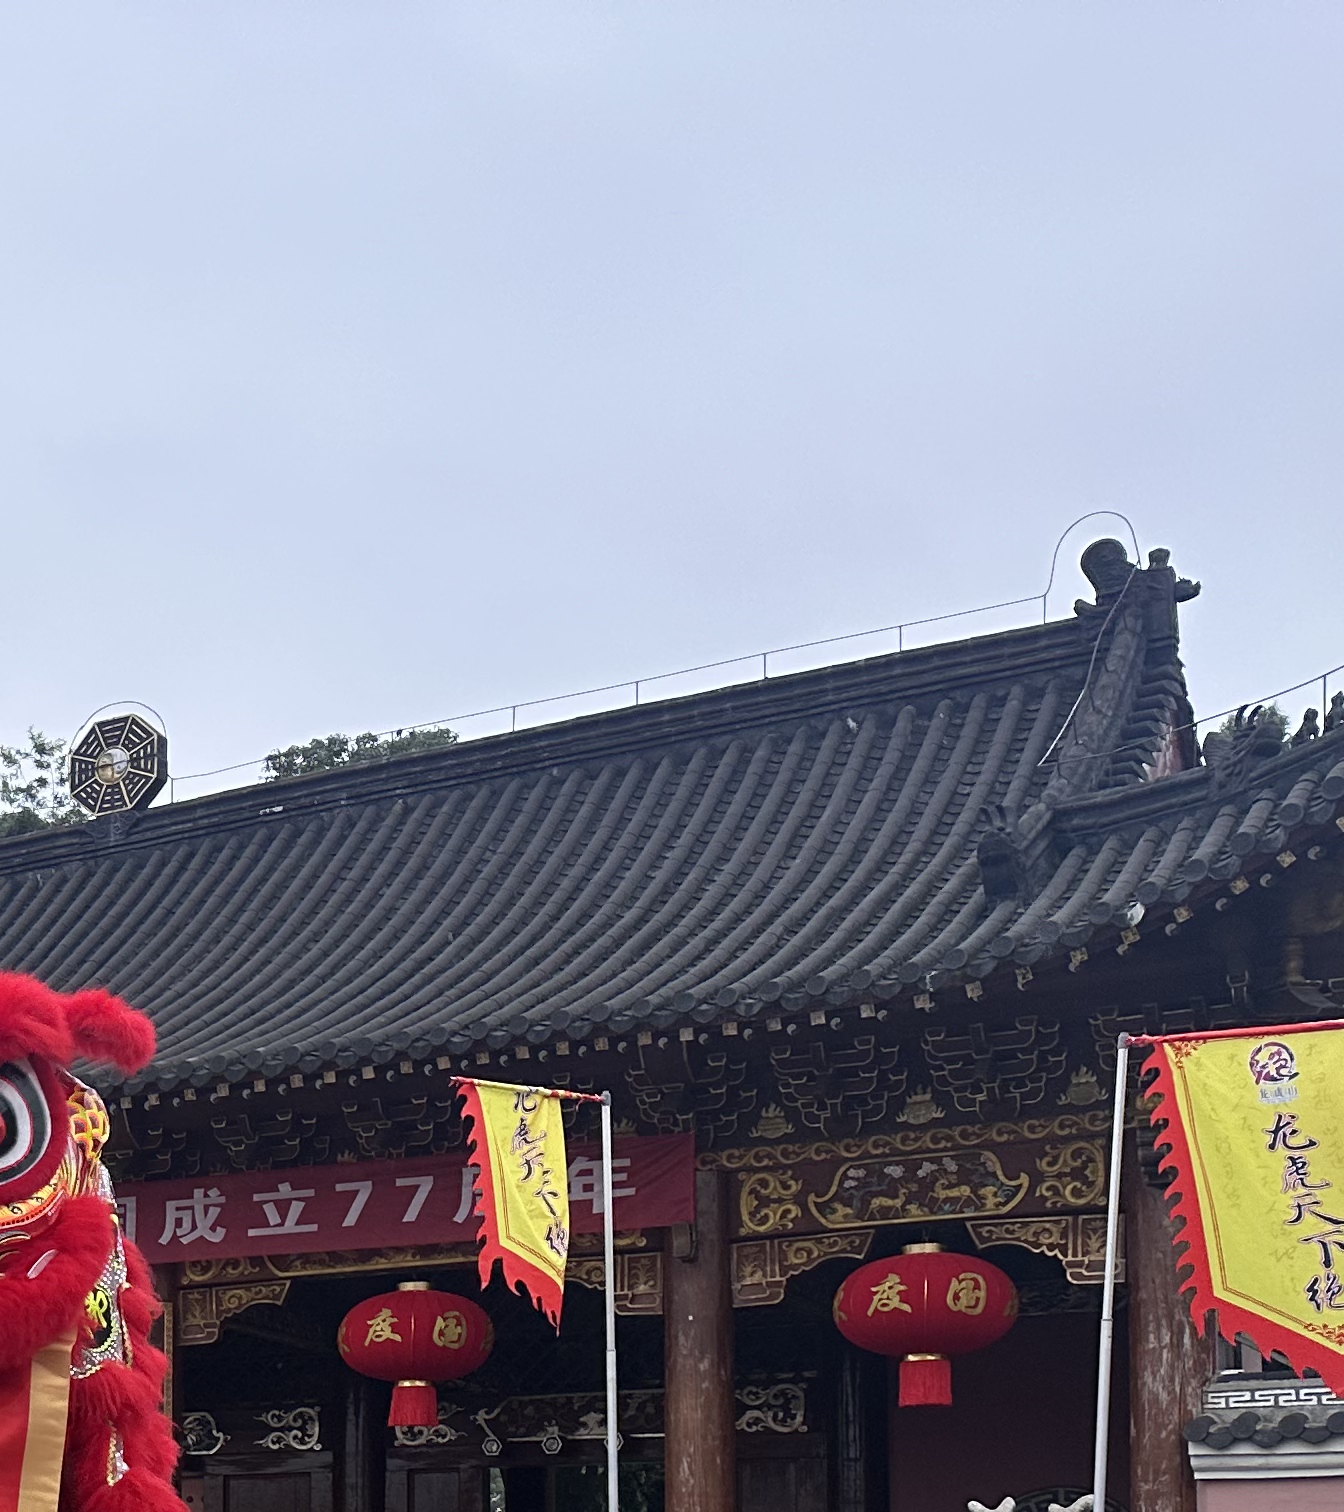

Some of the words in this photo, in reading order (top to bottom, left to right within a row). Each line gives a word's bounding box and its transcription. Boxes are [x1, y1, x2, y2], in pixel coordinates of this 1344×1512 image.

[1262, 1111, 1344, 1313] 龙虎天下绝
